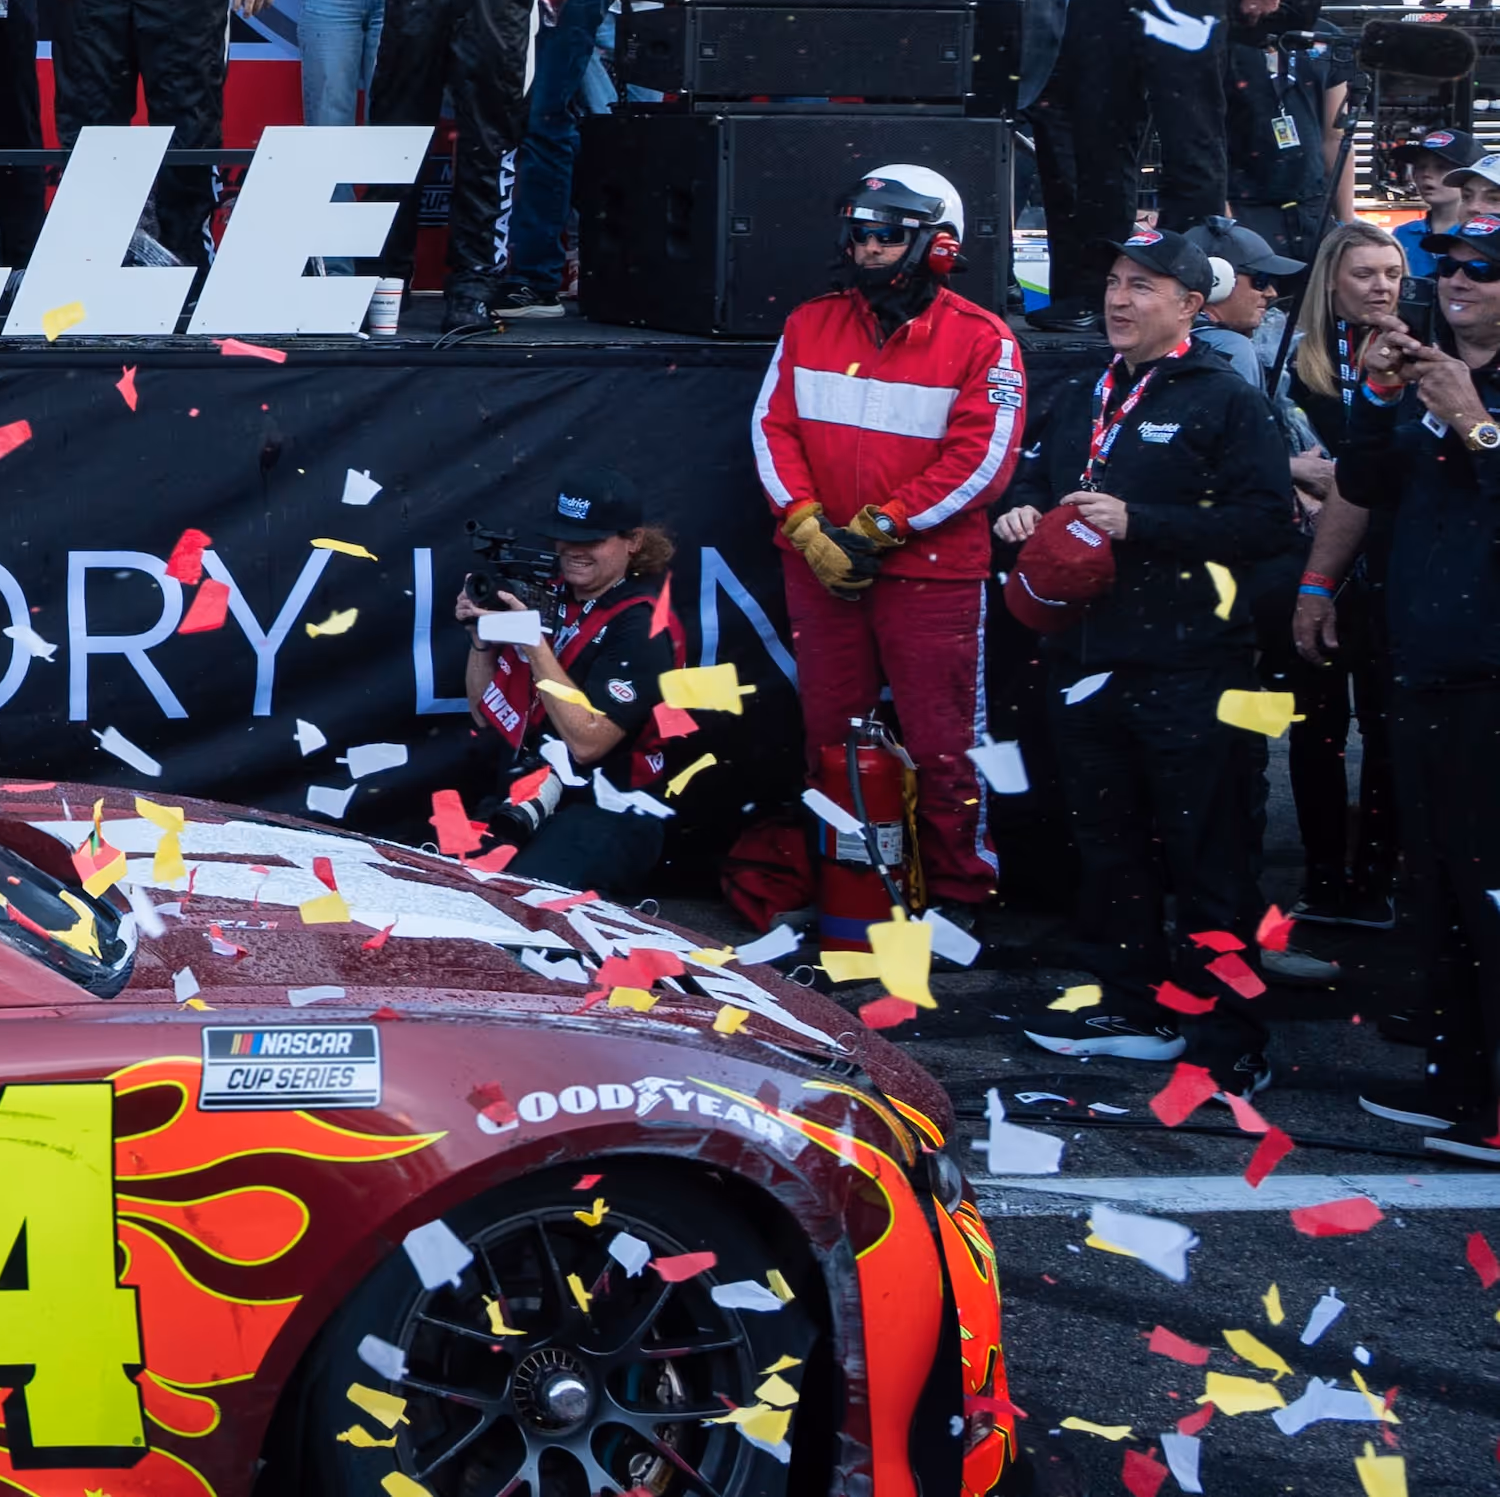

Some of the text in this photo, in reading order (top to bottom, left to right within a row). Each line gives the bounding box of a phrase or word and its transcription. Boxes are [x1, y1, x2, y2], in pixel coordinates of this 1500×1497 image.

[1101, 423, 1122, 454] NASCAR
[260, 1031, 353, 1056] NASCAR
[227, 1065, 356, 1091] CUP SERIES
